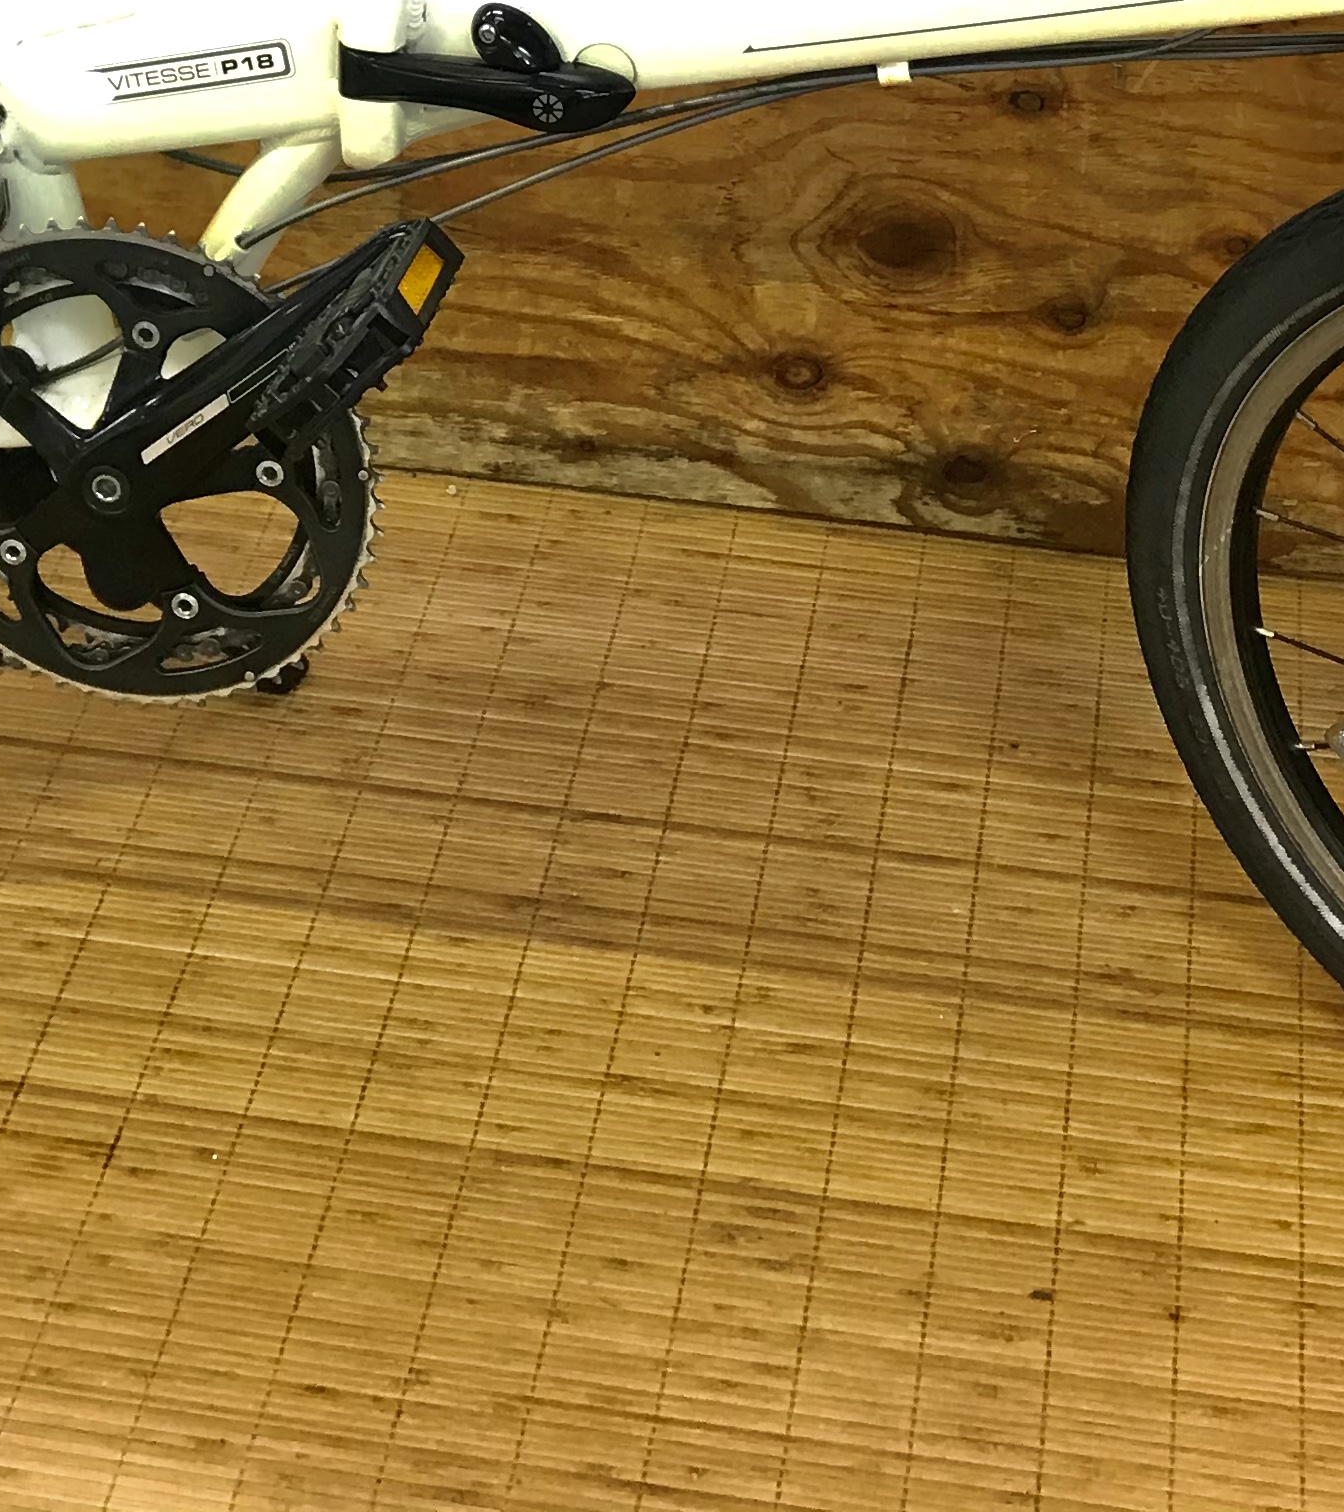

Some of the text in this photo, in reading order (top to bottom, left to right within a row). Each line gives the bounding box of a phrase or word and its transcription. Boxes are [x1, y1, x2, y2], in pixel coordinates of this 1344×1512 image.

[106, 52, 276, 92] VITESSE P18
[166, 412, 205, 445] VERO
